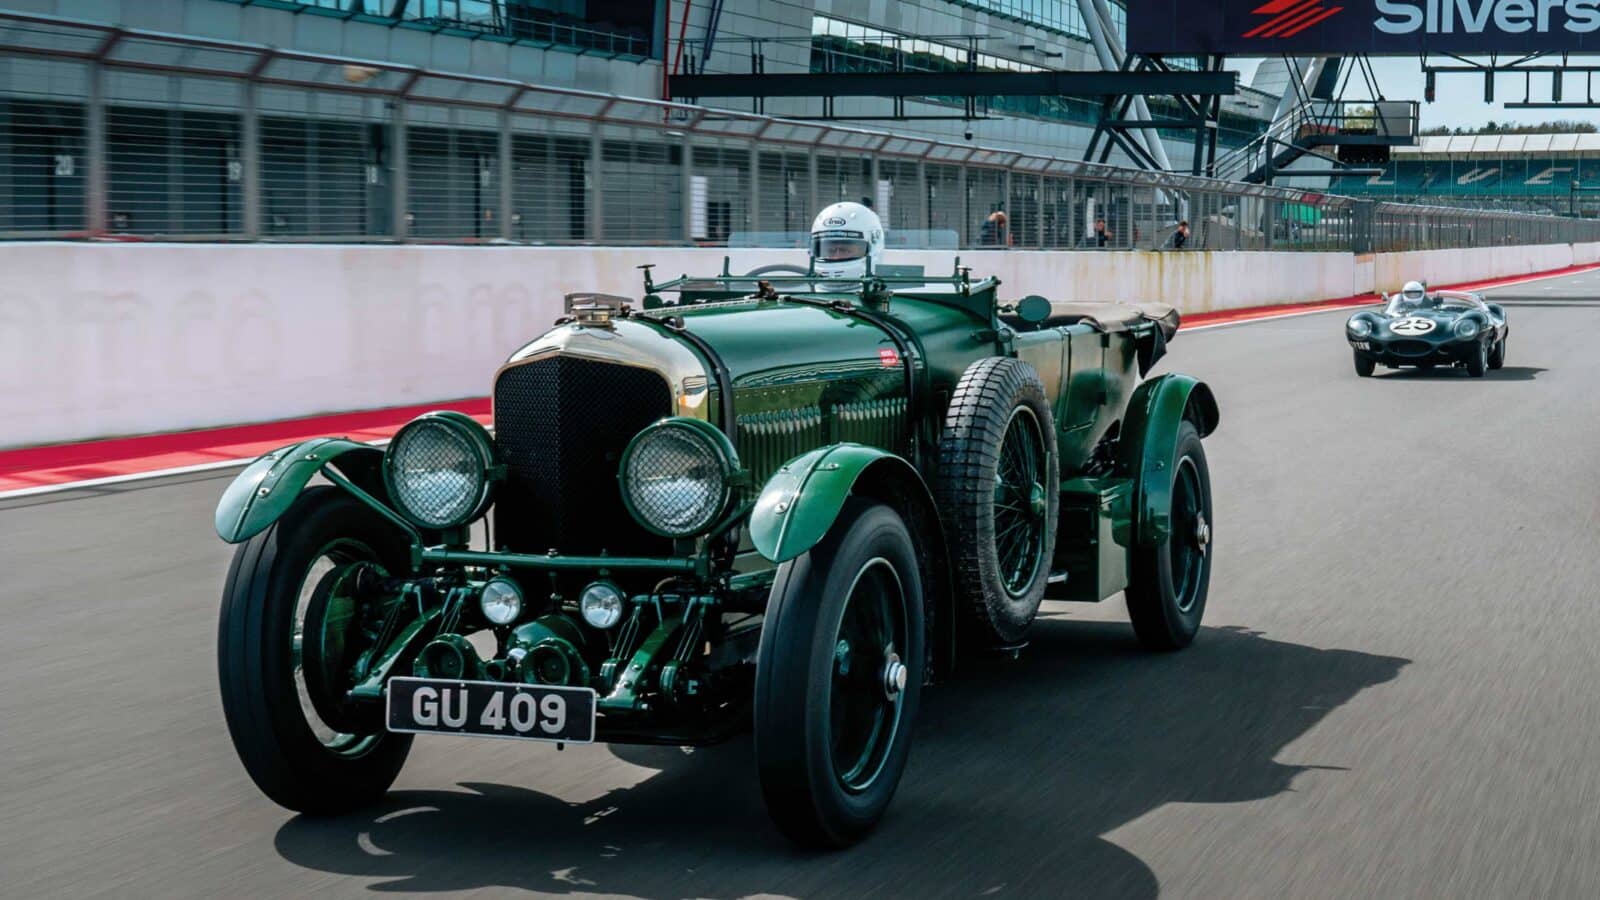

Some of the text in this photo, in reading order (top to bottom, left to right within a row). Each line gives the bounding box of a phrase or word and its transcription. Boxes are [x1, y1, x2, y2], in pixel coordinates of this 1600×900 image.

[1373, 0, 1600, 34] Silvers
[1393, 319, 1433, 331] 25
[412, 686, 567, 734] GU 409
